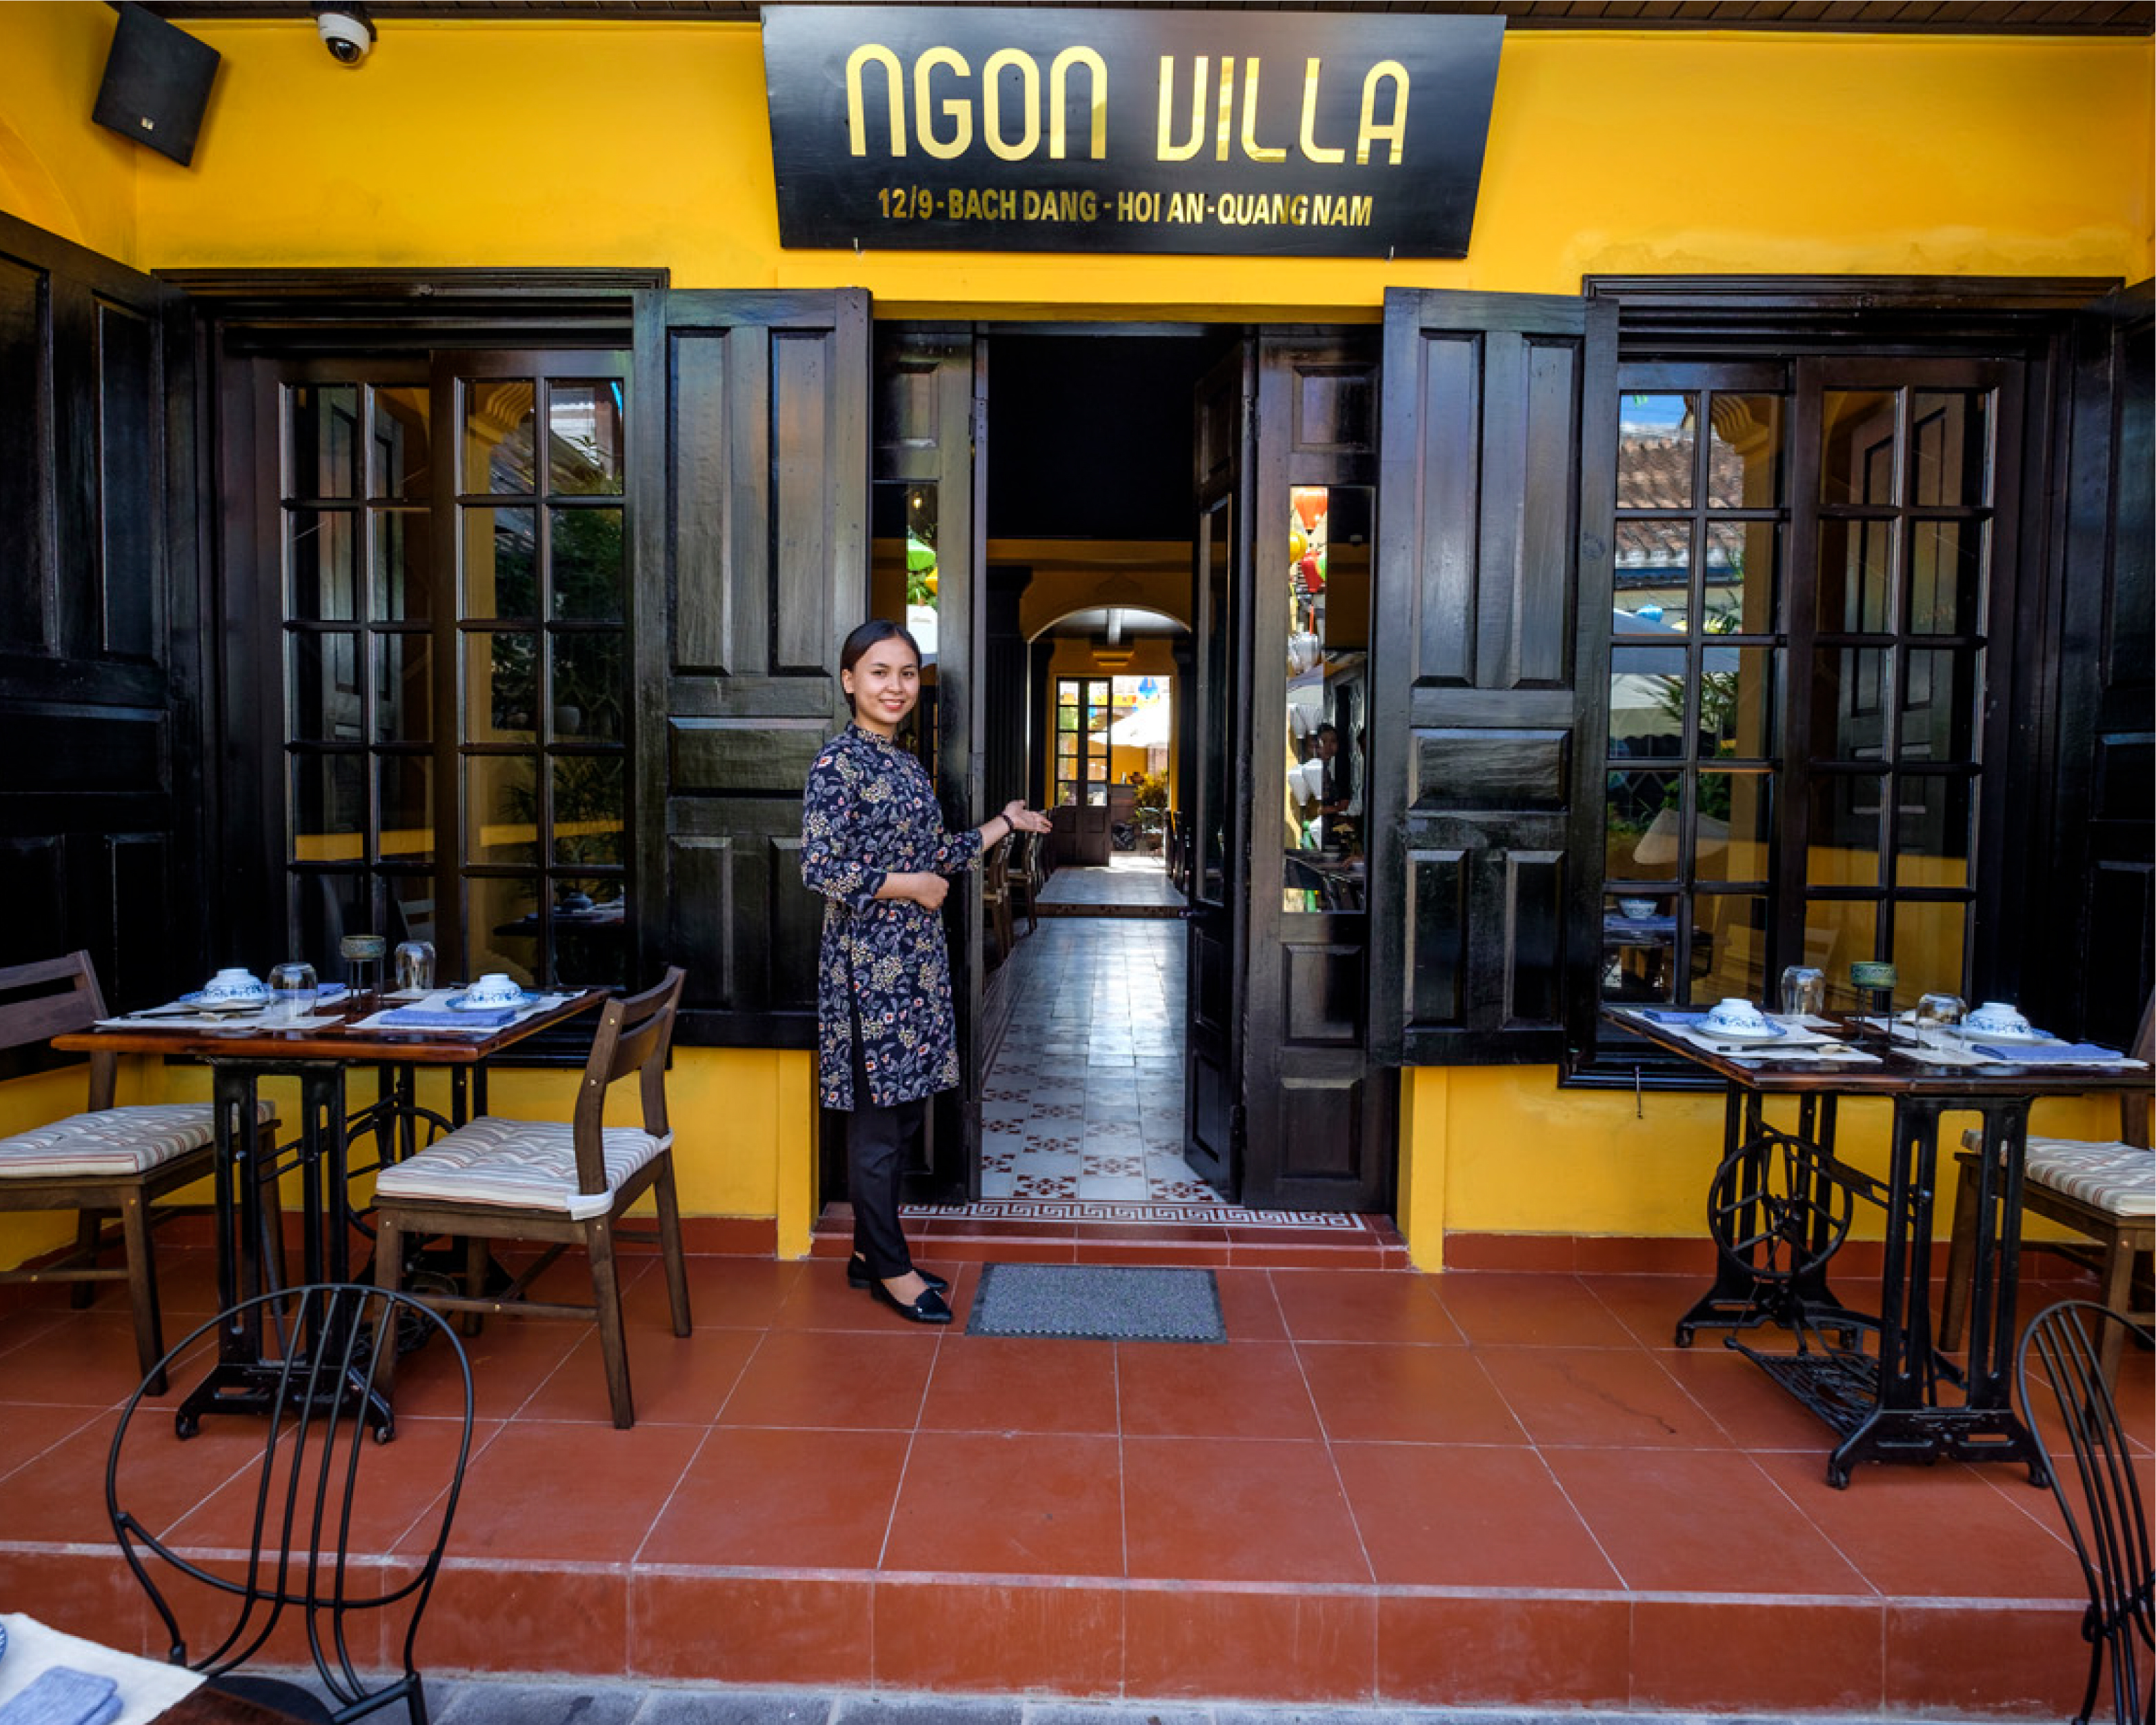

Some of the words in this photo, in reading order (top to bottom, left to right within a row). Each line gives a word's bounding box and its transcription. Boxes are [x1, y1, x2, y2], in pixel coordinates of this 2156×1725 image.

[846, 43, 1108, 161] NGON
[1157, 55, 1410, 166] VILLA
[1023, 190, 1096, 221] DANG
[1118, 191, 1160, 222] HOI
